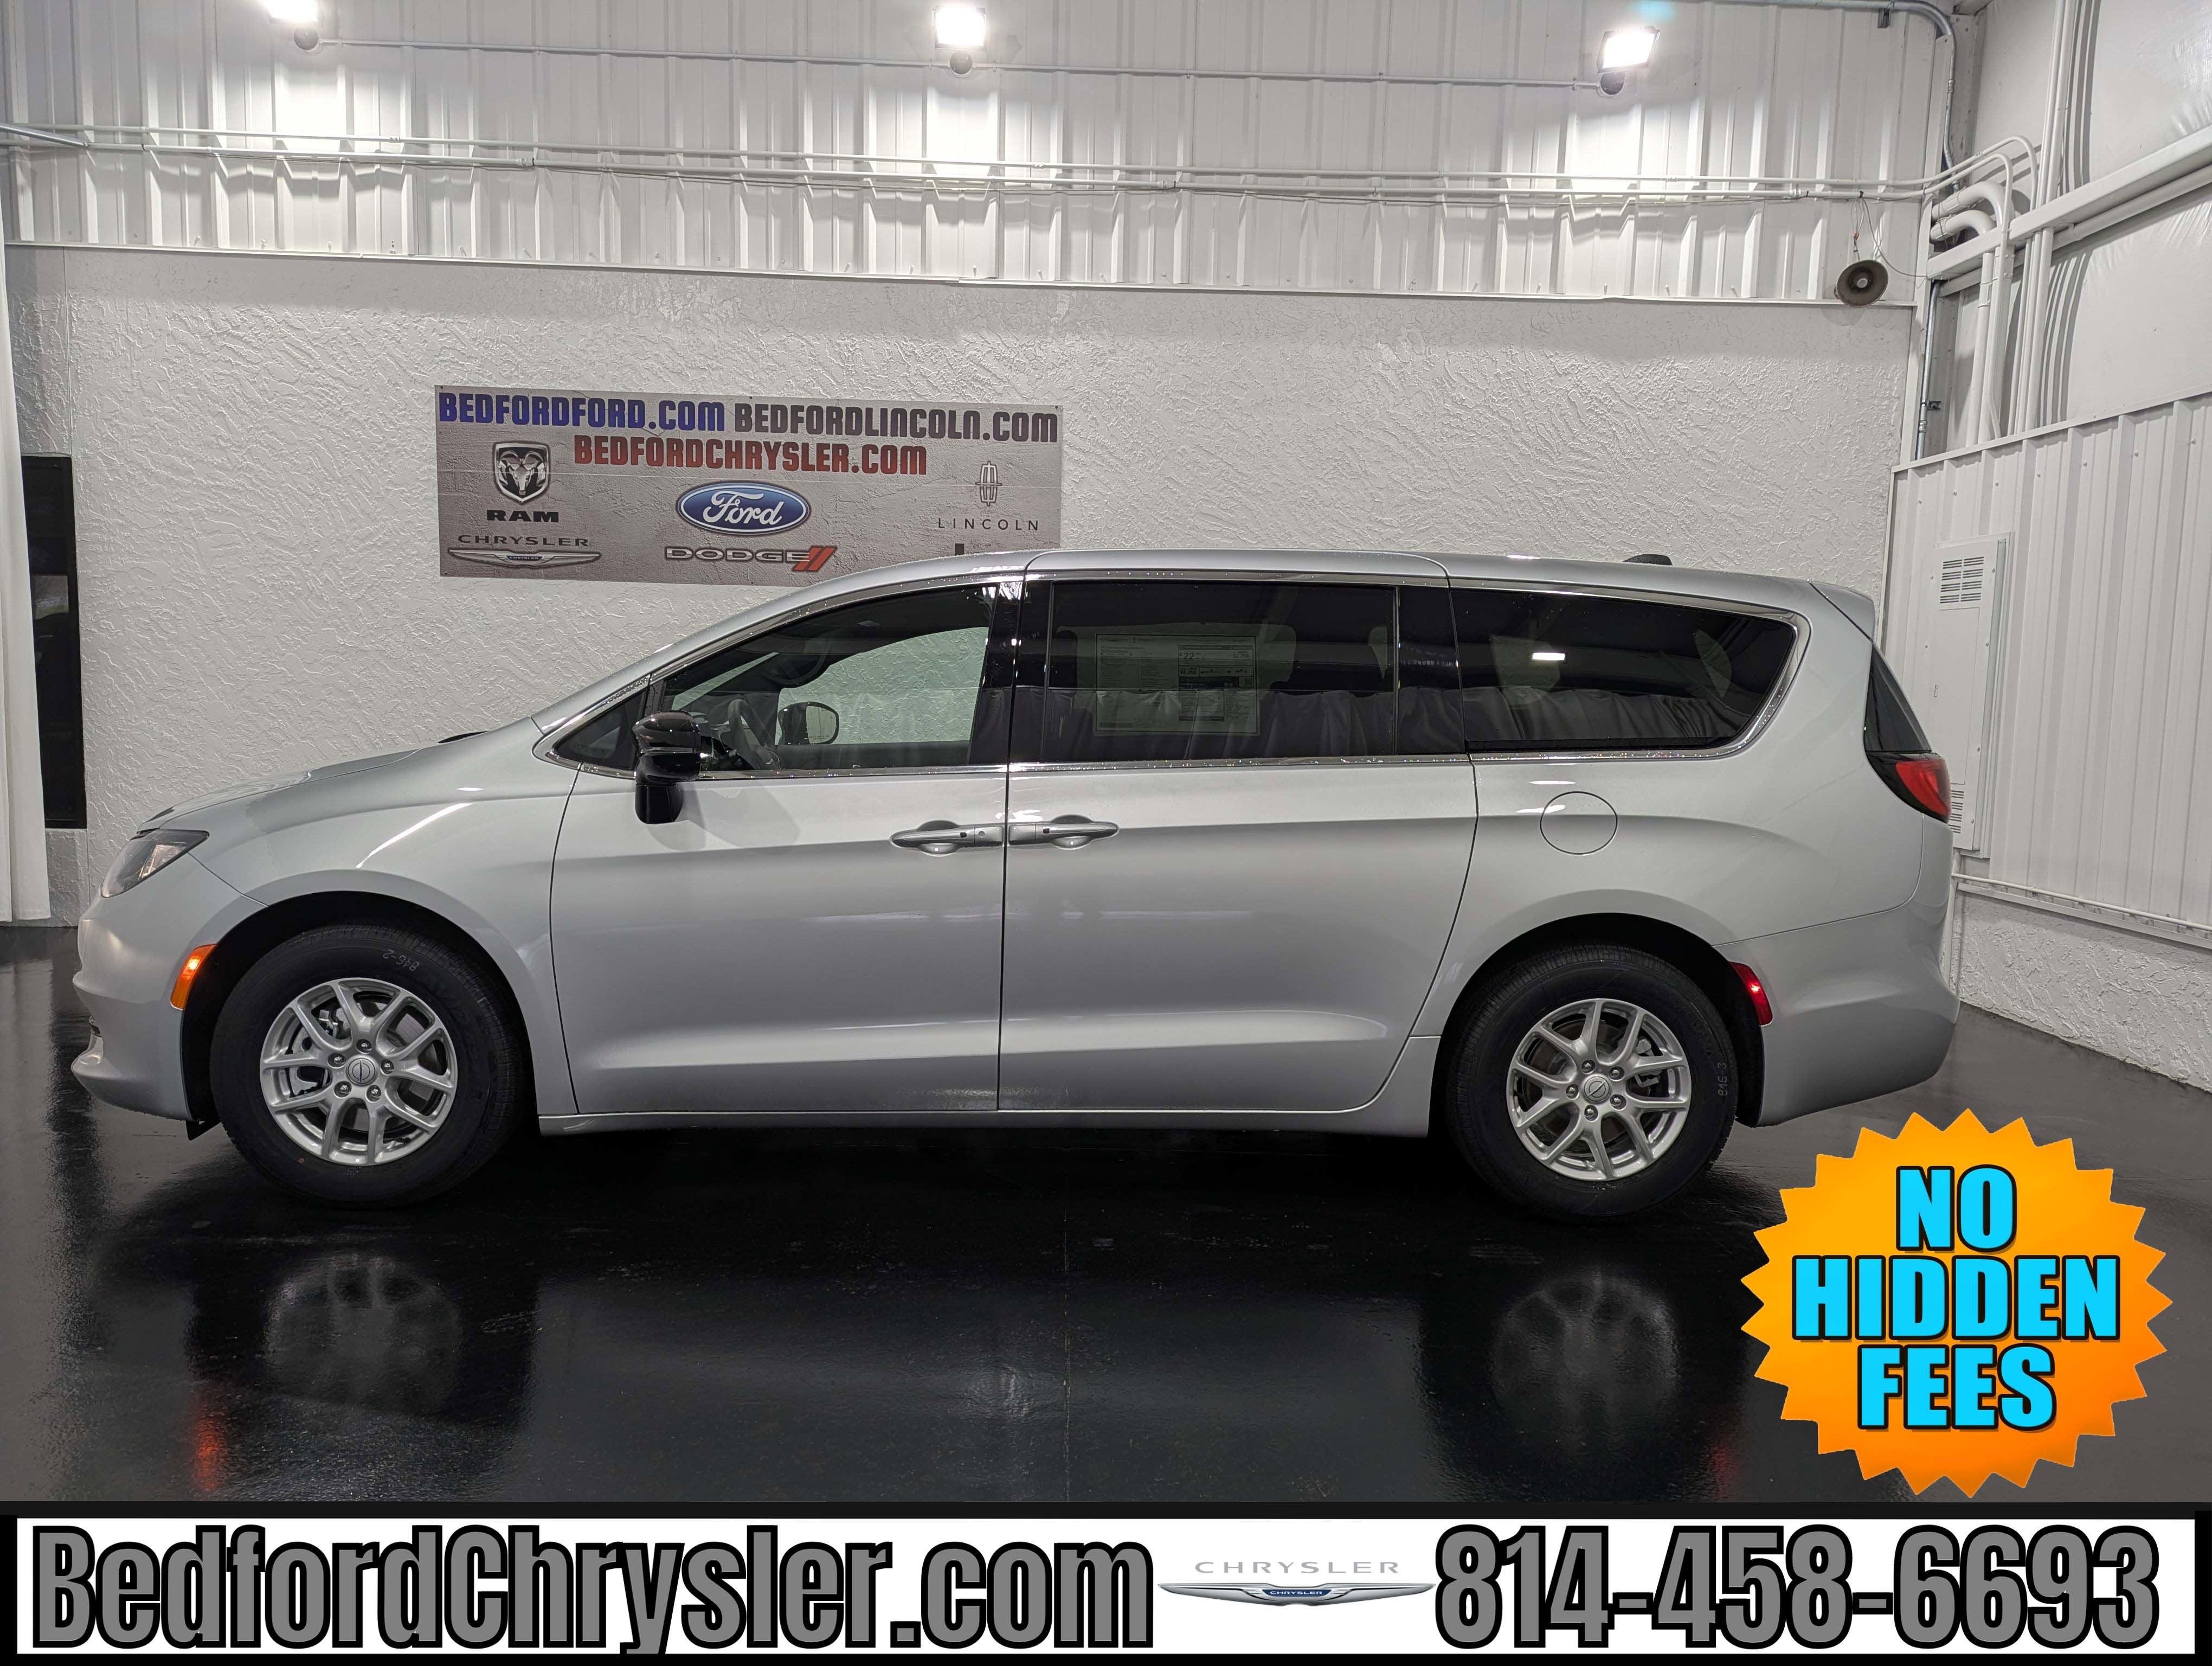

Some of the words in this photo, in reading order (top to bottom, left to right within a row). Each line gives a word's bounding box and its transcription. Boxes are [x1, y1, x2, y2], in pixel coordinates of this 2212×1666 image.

[439, 392, 725, 432] BEDFORDFORD.COM
[735, 402, 1058, 443] BEDFORDLINCOLN.COM
[574, 434, 927, 475] BEDFORDCHRYSLER.COM
[703, 490, 785, 526] Ford
[486, 509, 560, 523] RAM
[937, 517, 1039, 531] LINCOLN
[458, 535, 589, 547] CHRYSLER
[666, 547, 810, 562] DODGE
